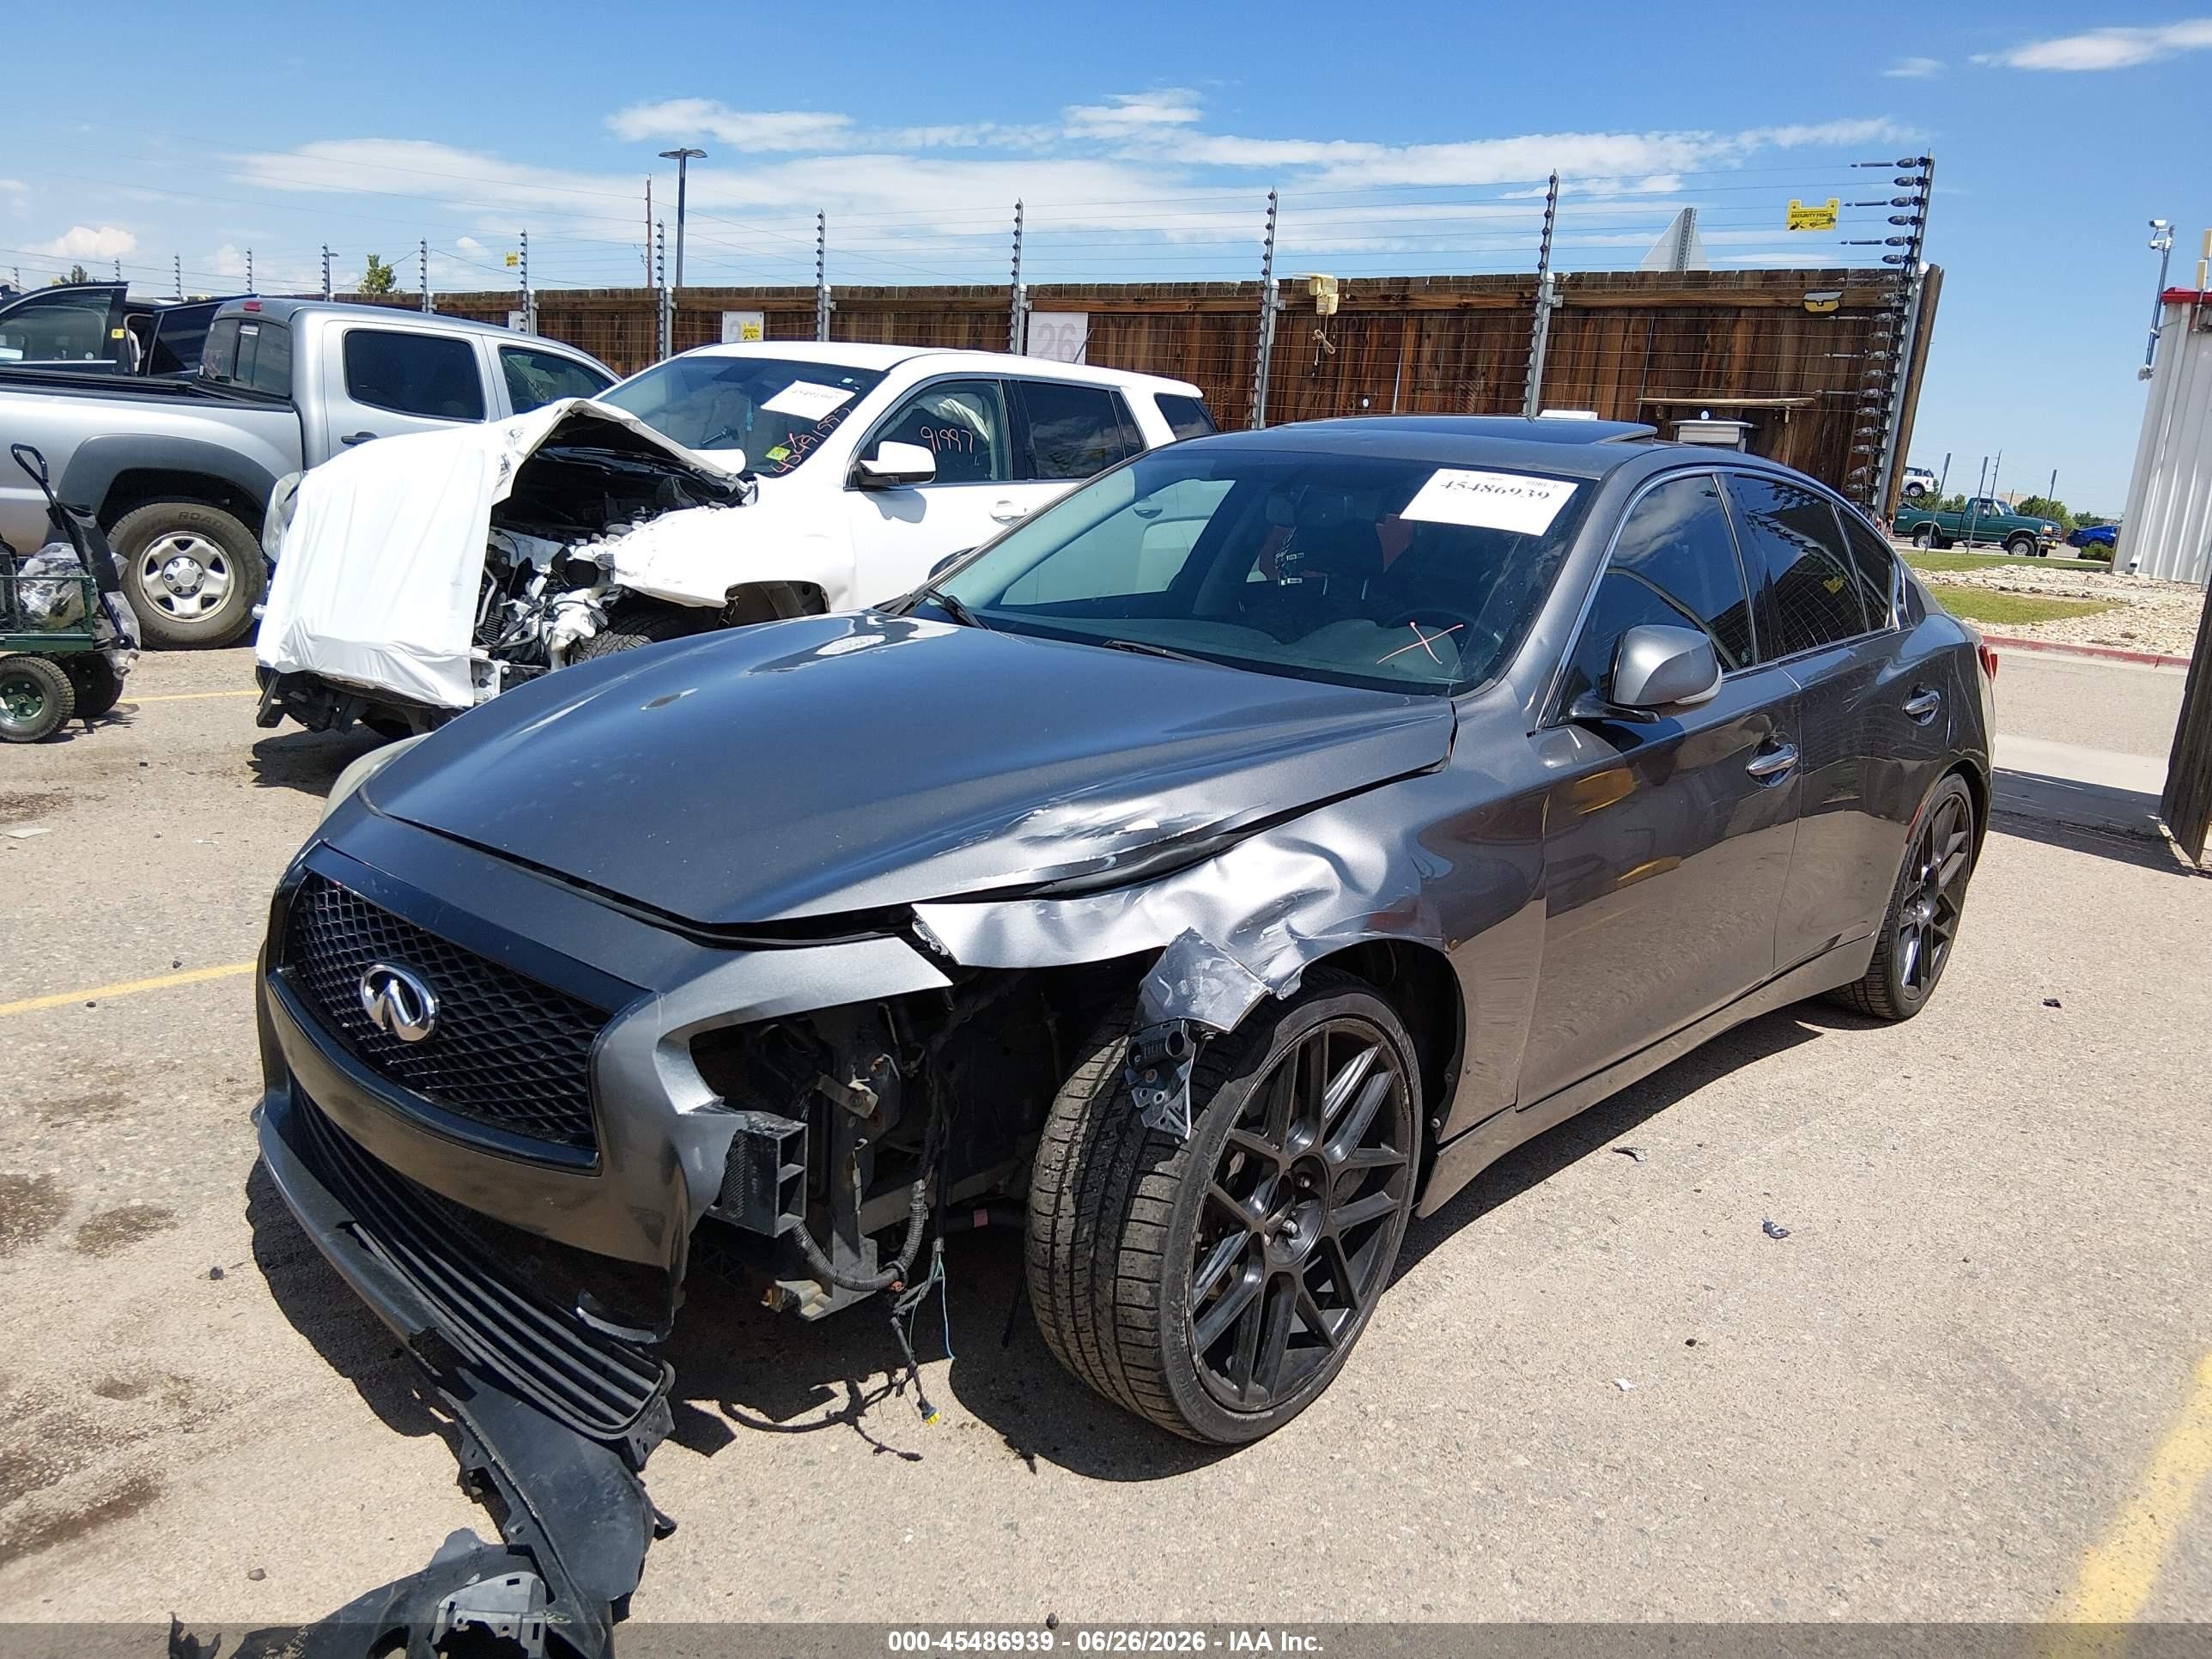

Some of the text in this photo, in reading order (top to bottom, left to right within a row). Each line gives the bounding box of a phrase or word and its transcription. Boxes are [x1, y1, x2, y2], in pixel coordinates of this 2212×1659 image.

[1037, 322, 1077, 362] 26
[920, 426, 974, 455] 91997
[1440, 479, 1551, 500] 45486939
